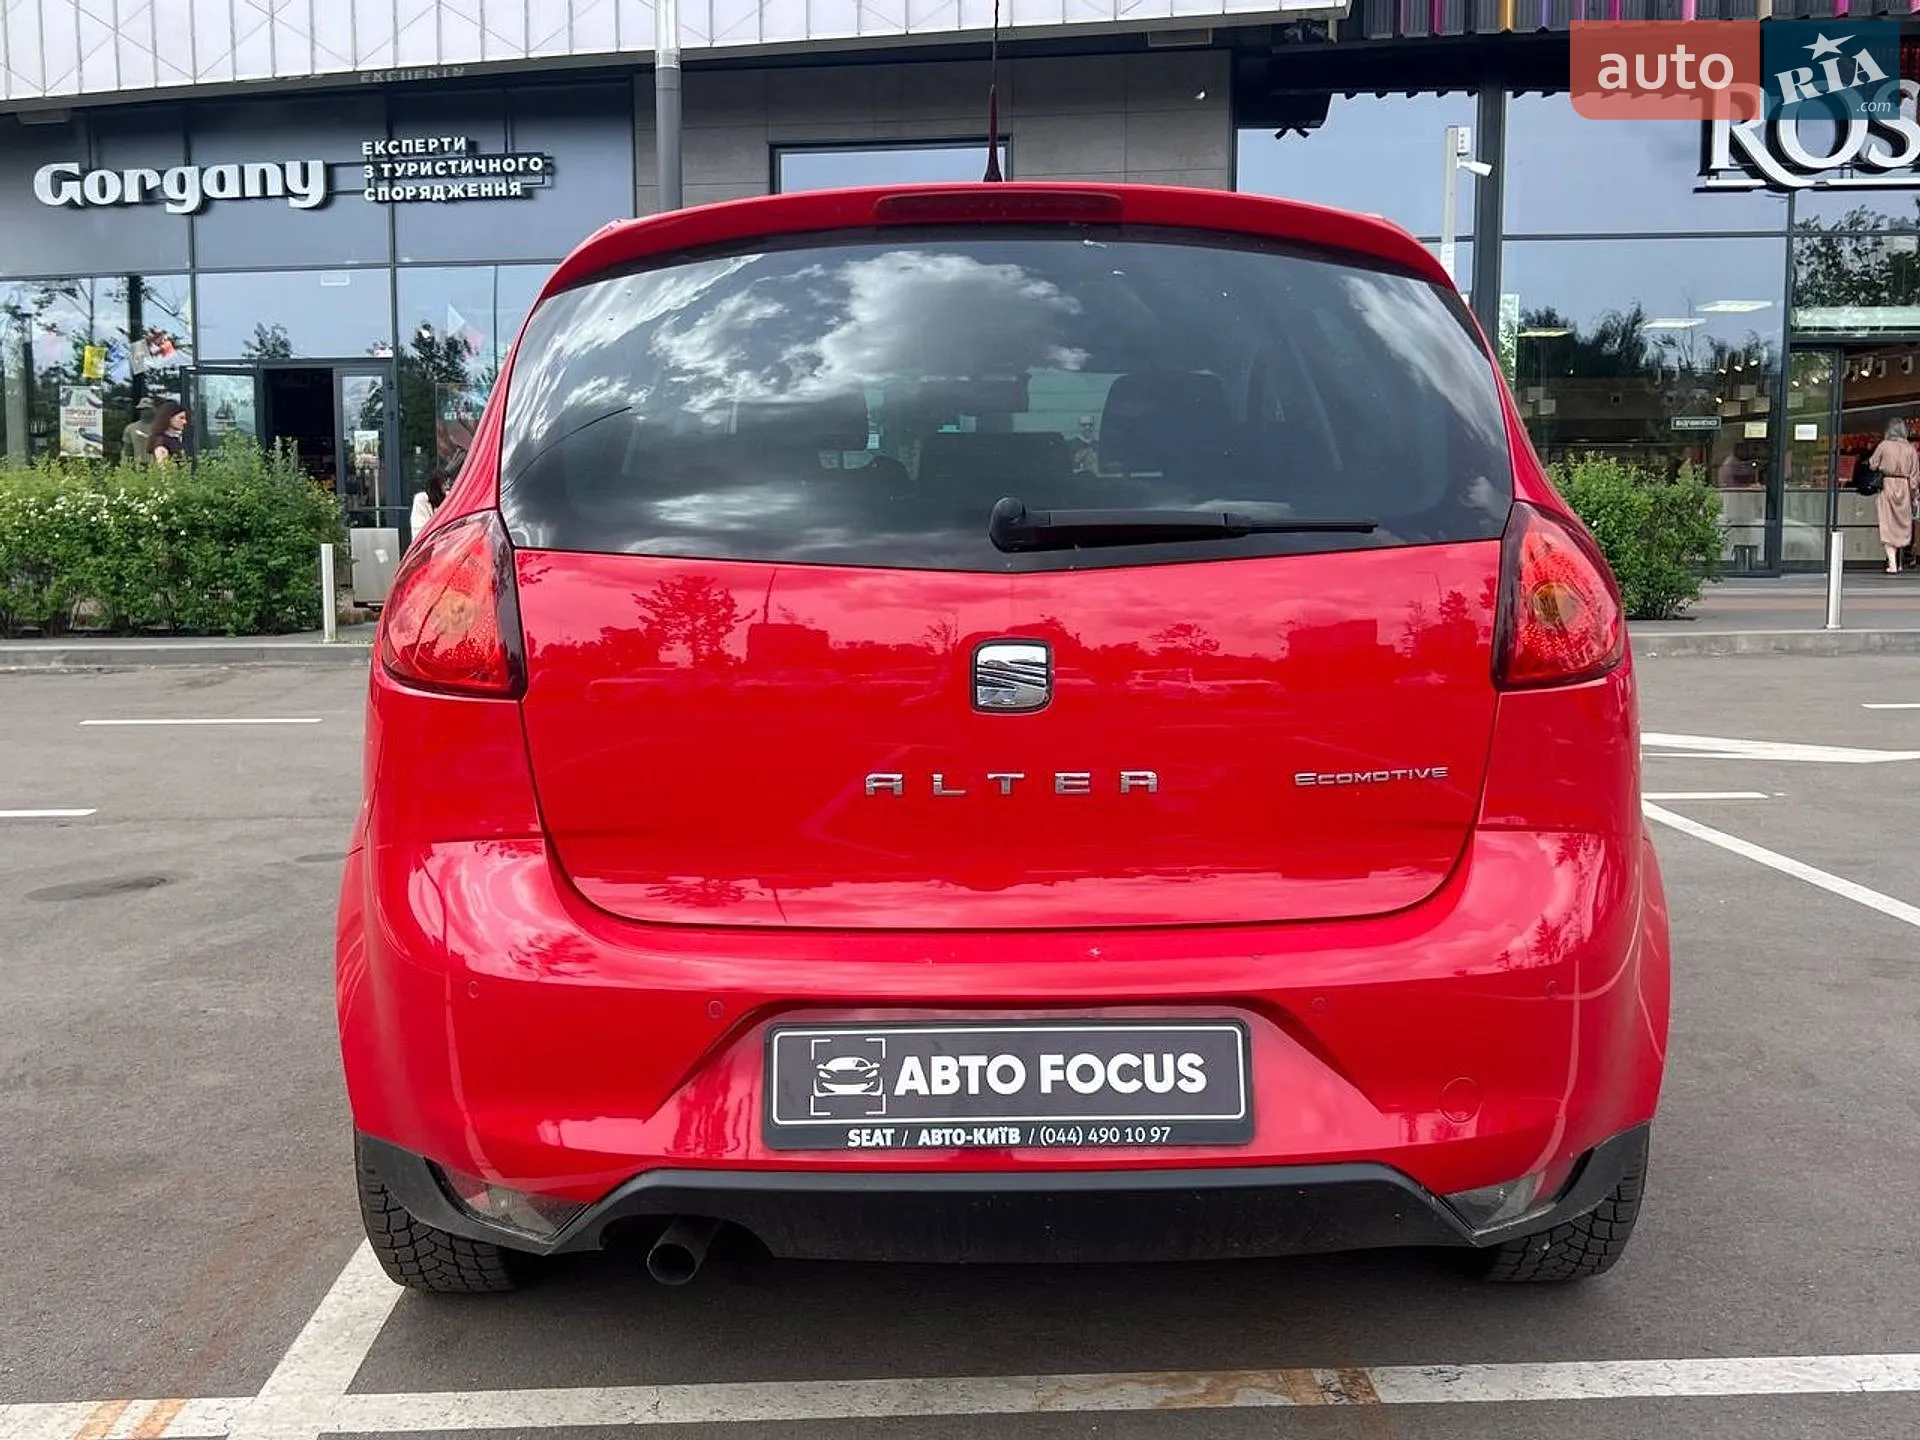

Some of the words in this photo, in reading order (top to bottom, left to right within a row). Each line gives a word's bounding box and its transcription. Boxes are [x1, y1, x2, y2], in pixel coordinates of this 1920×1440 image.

[361, 137, 466, 156] ЕКСПЕРТИ
[381, 157, 544, 177] ТУРИСТИЧНОГО
[33, 160, 325, 214] Gorgany
[363, 182, 522, 202] СПОРЯДЖЕННЯ
[865, 771, 1158, 796] ALTEA
[894, 1054, 1026, 1096] АВТО
[1039, 1052, 1207, 1095] FOCUS
[847, 1128, 894, 1147] SEAT
[918, 1126, 1021, 1147] АВТО-КИЇВ
[1039, 1126, 1083, 1146] (044)
[1088, 1126, 1120, 1144] 490
[1125, 1126, 1146, 1143] 10
[1149, 1126, 1171, 1143] 97
